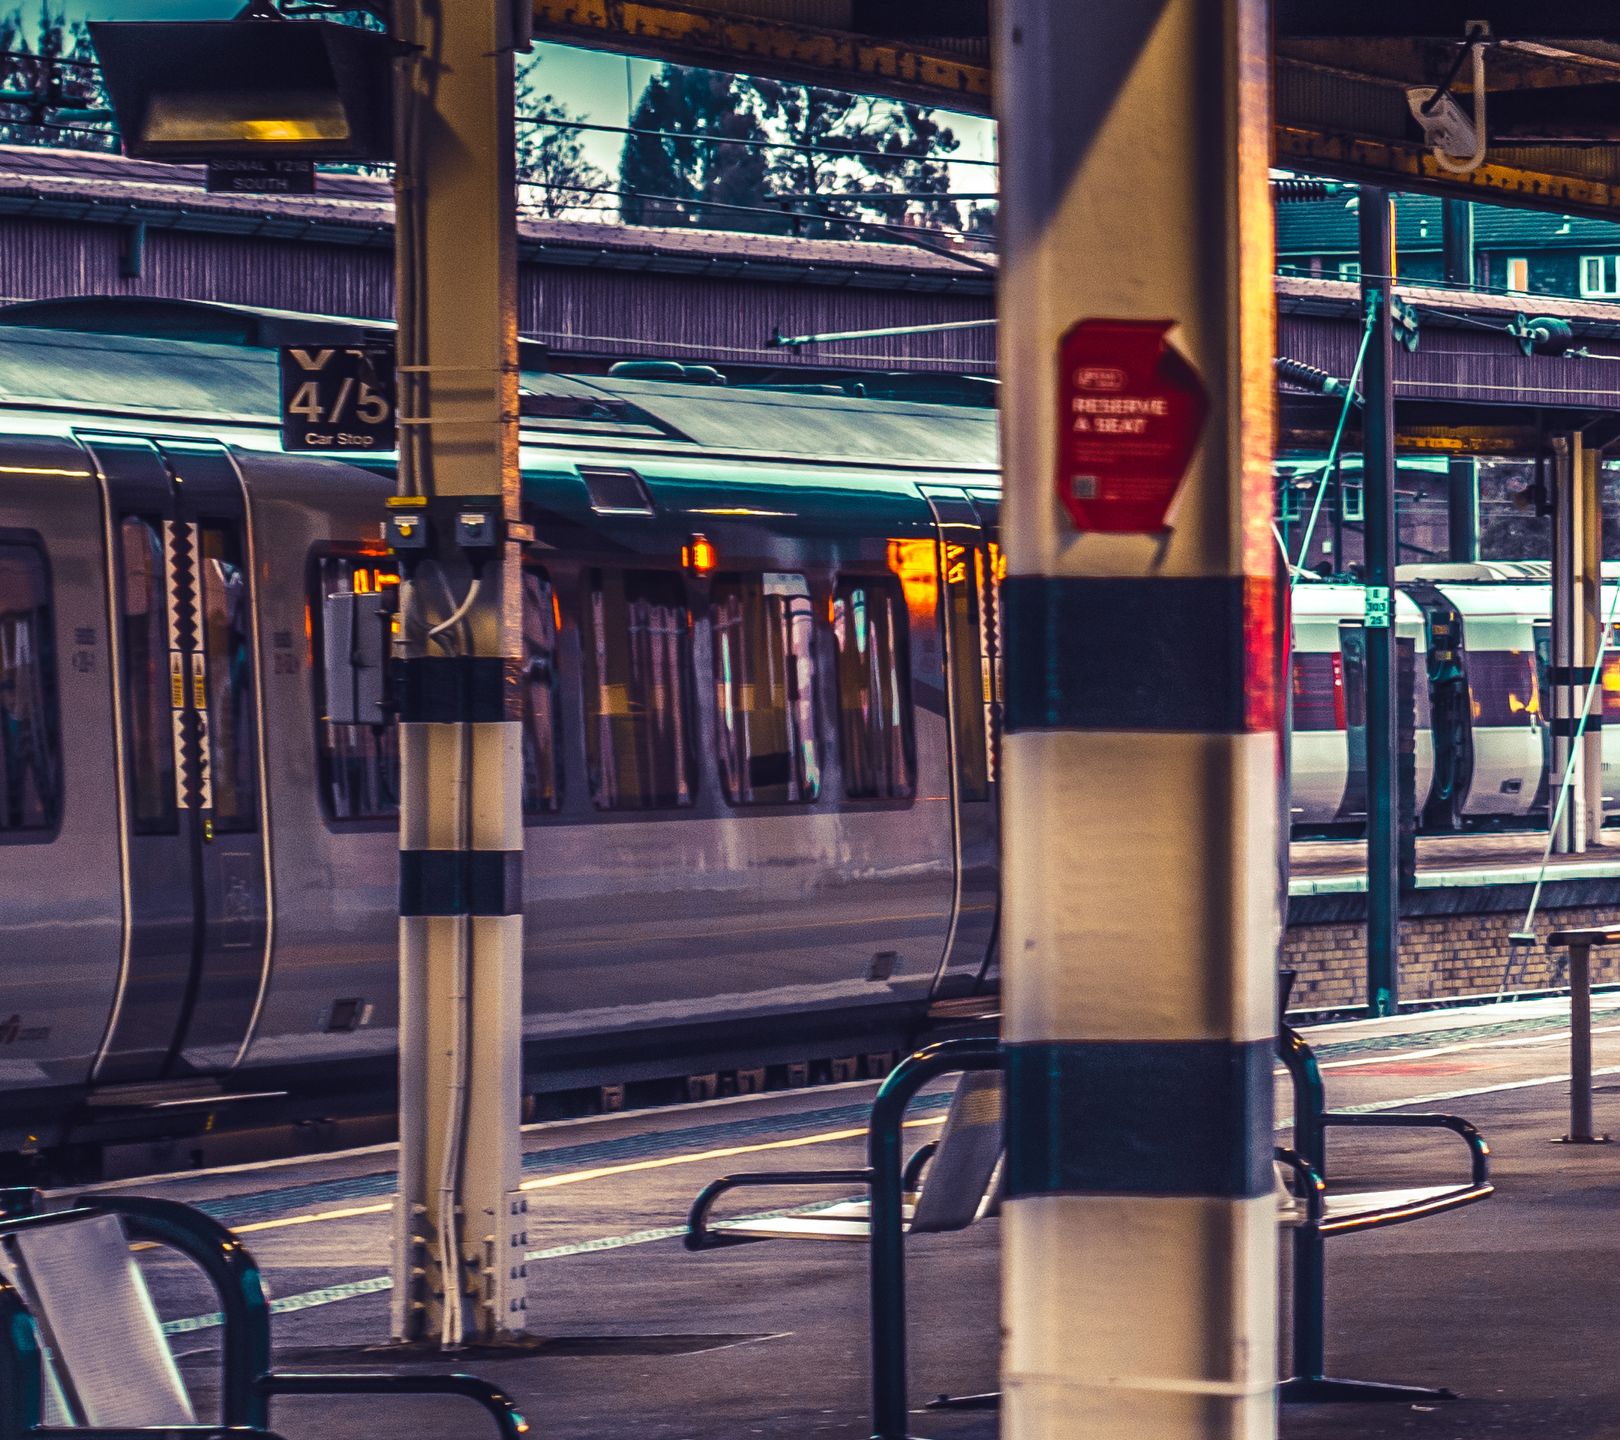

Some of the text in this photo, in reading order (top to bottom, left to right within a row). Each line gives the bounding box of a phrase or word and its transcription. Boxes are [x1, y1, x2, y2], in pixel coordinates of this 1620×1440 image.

[233, 177, 288, 191] SOUTH
[289, 377, 390, 425] 4/5
[1072, 397, 1169, 415] RESERVE
[1073, 417, 1149, 434] A SEAT
[305, 432, 375, 448] Car Stop
